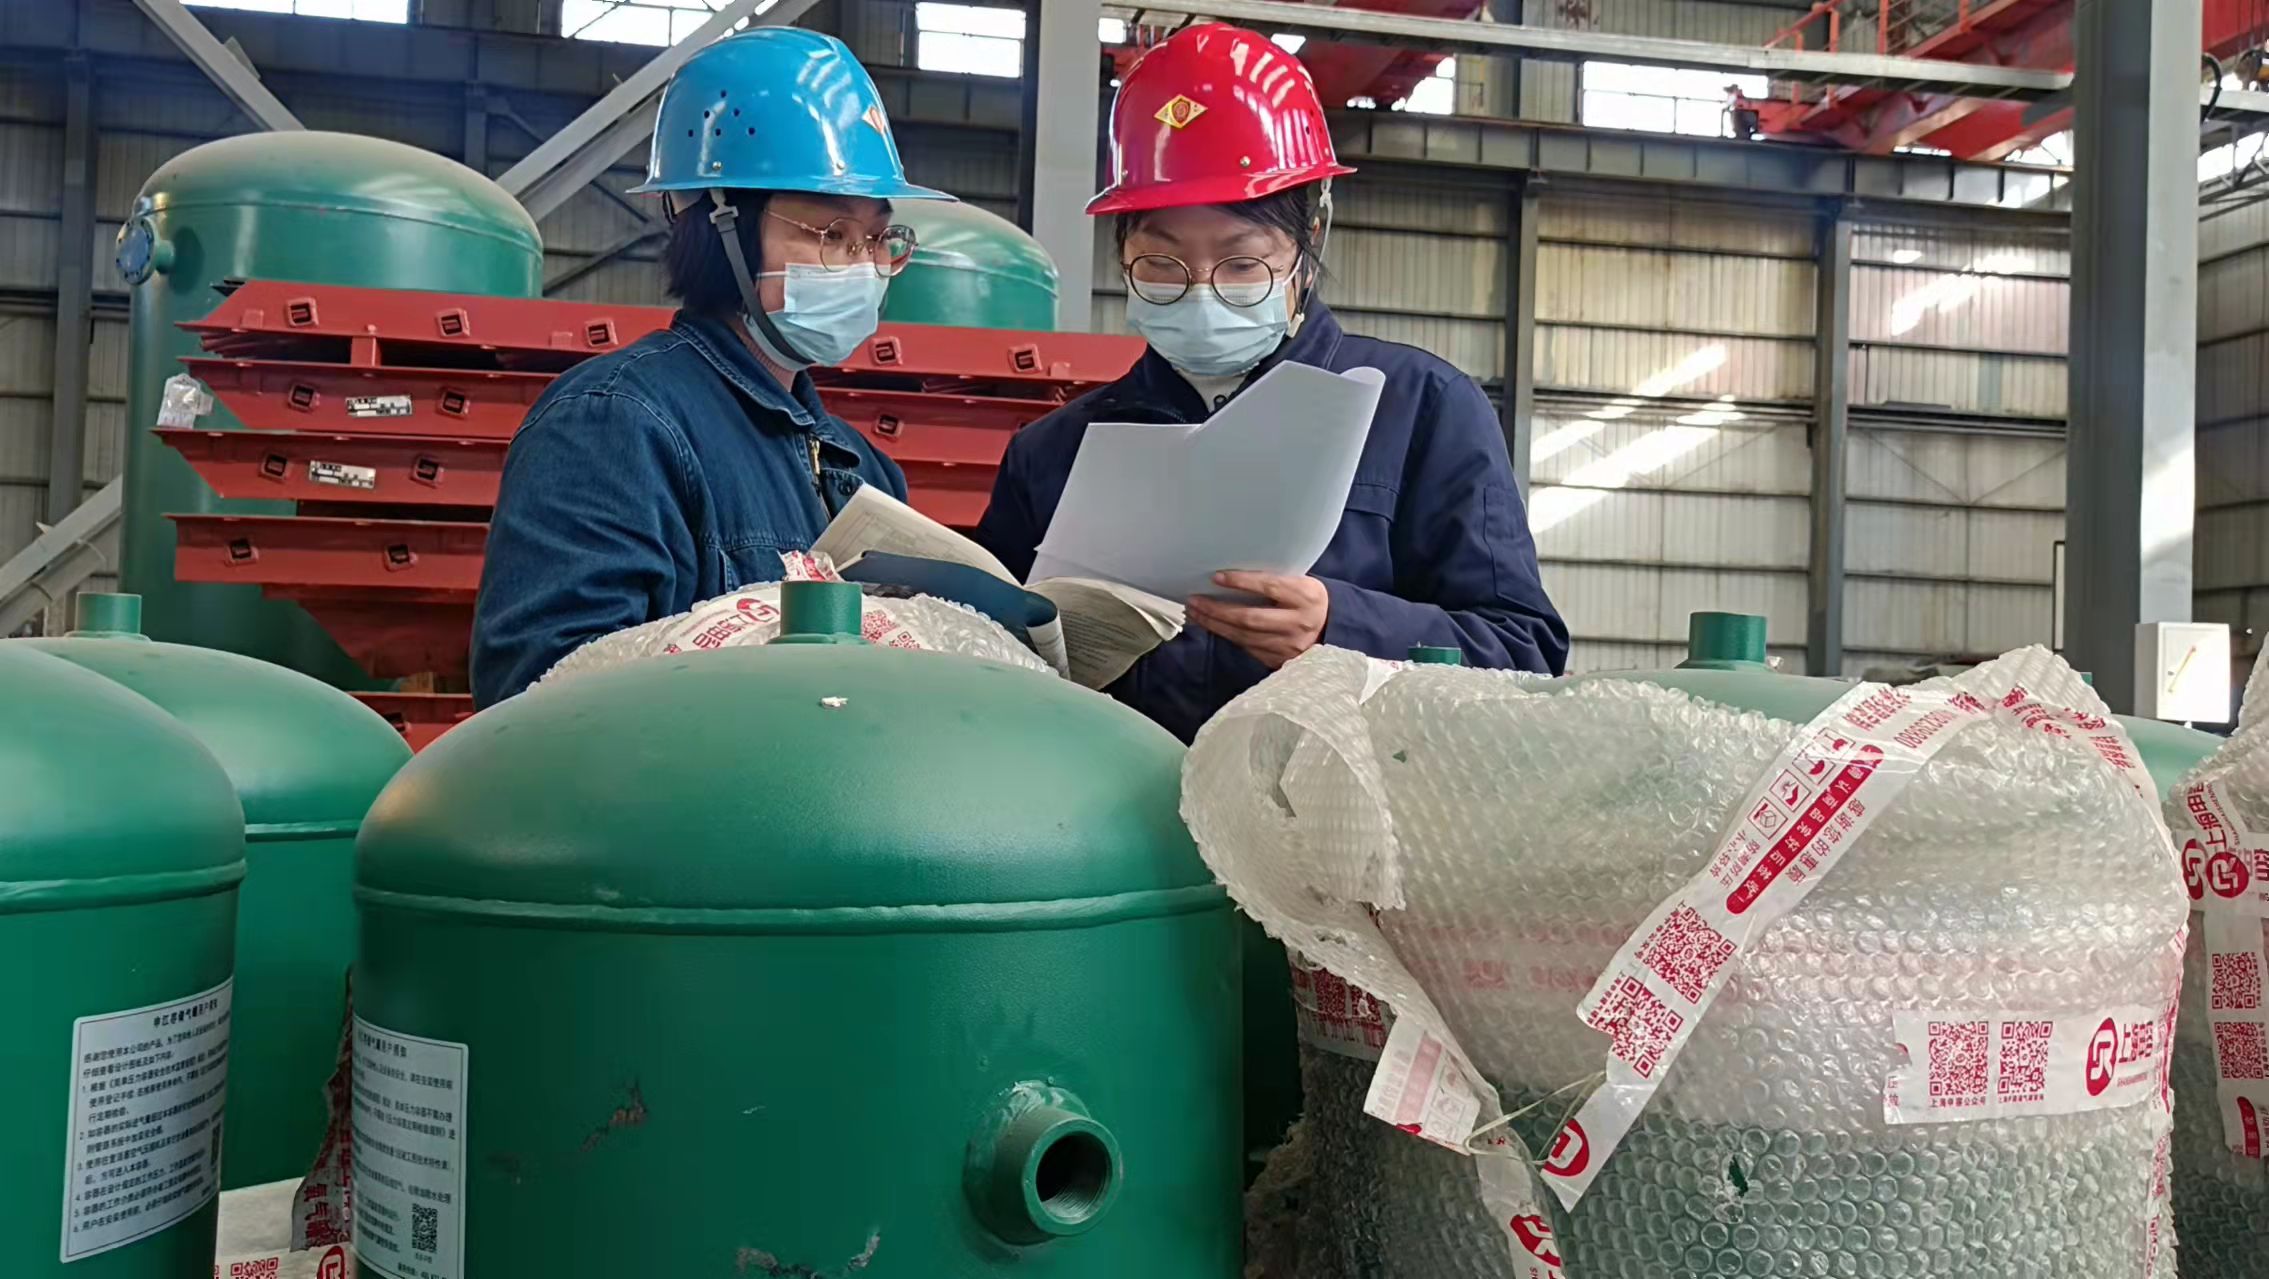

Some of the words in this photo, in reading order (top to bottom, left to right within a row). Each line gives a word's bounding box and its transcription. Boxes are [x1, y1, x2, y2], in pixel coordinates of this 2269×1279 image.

[1709, 829, 1746, 878] 小心轻放
[1720, 839, 1760, 888] 防潮防压
[1784, 798, 1865, 888] 感谢您的惠顾
